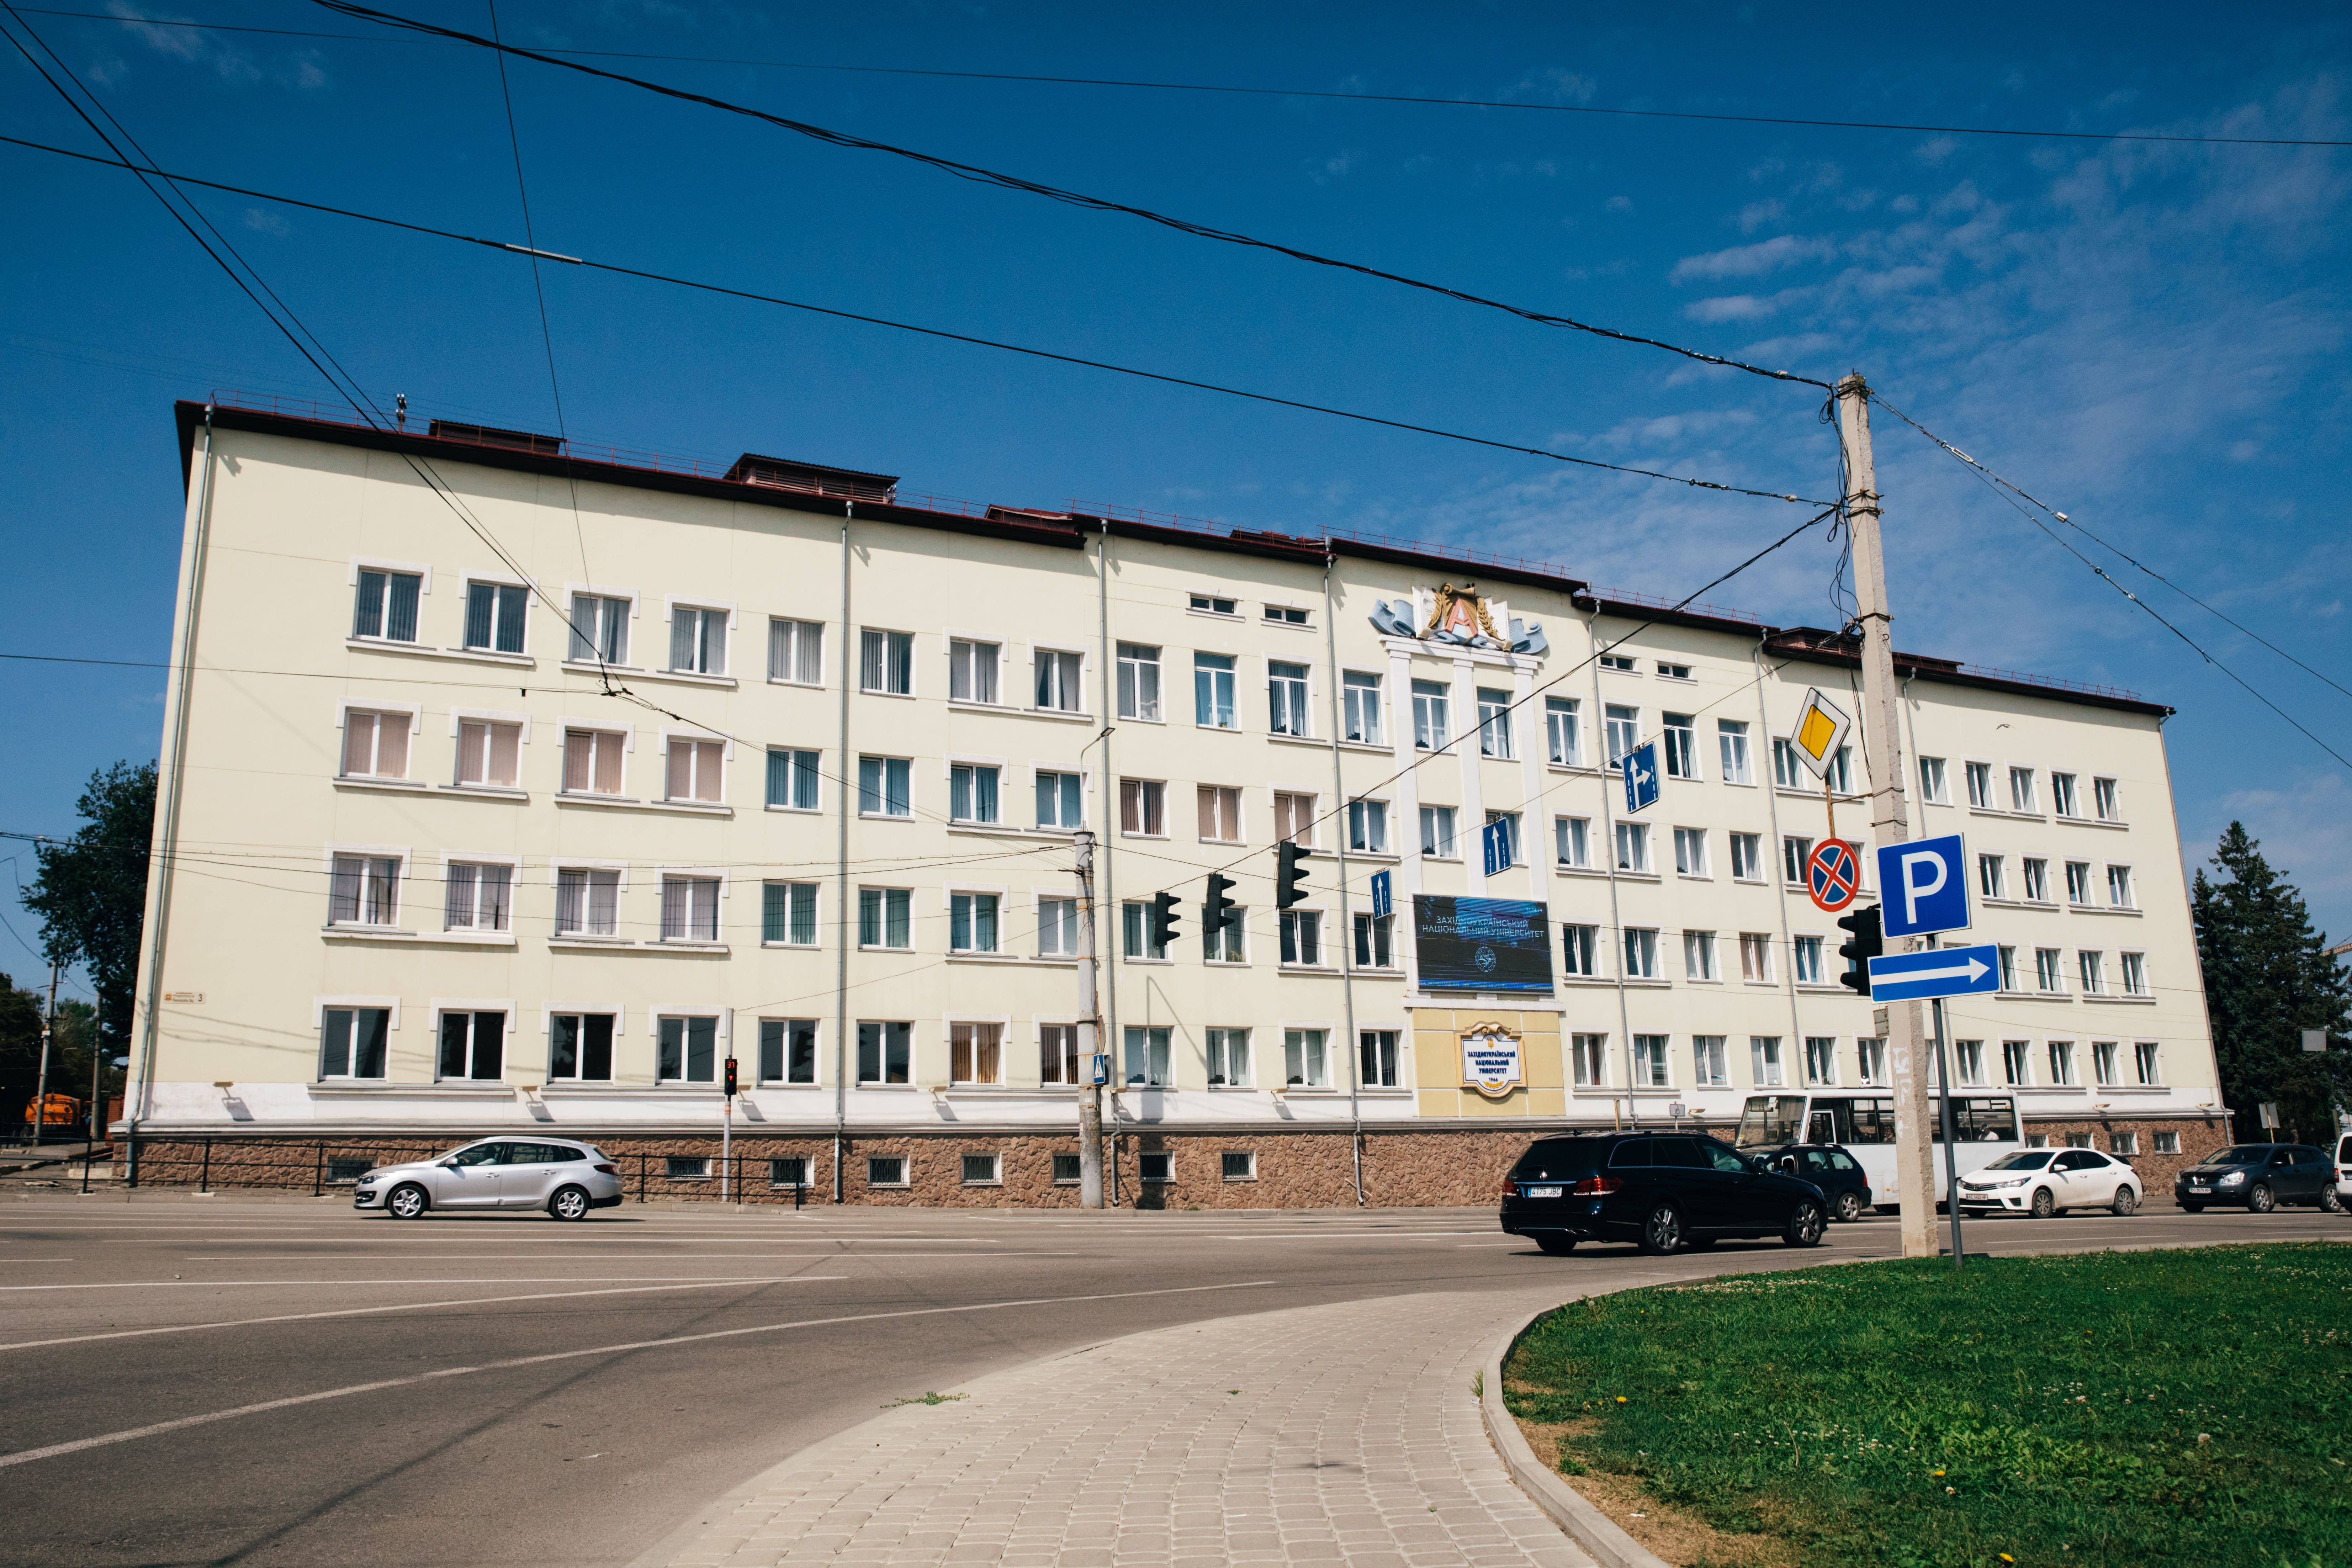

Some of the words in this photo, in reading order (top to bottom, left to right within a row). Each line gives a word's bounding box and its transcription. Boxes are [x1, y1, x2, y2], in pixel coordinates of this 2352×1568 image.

[1901, 851, 1947, 924] P
[1436, 916, 1528, 928] ЗАХІДНОУКРАЇНСЬКИЙ
[1423, 925, 1488, 936] НАЦІОНАЛЬНИЙ
[1489, 928, 1544, 938] УНІВЕРСИТЕТ
